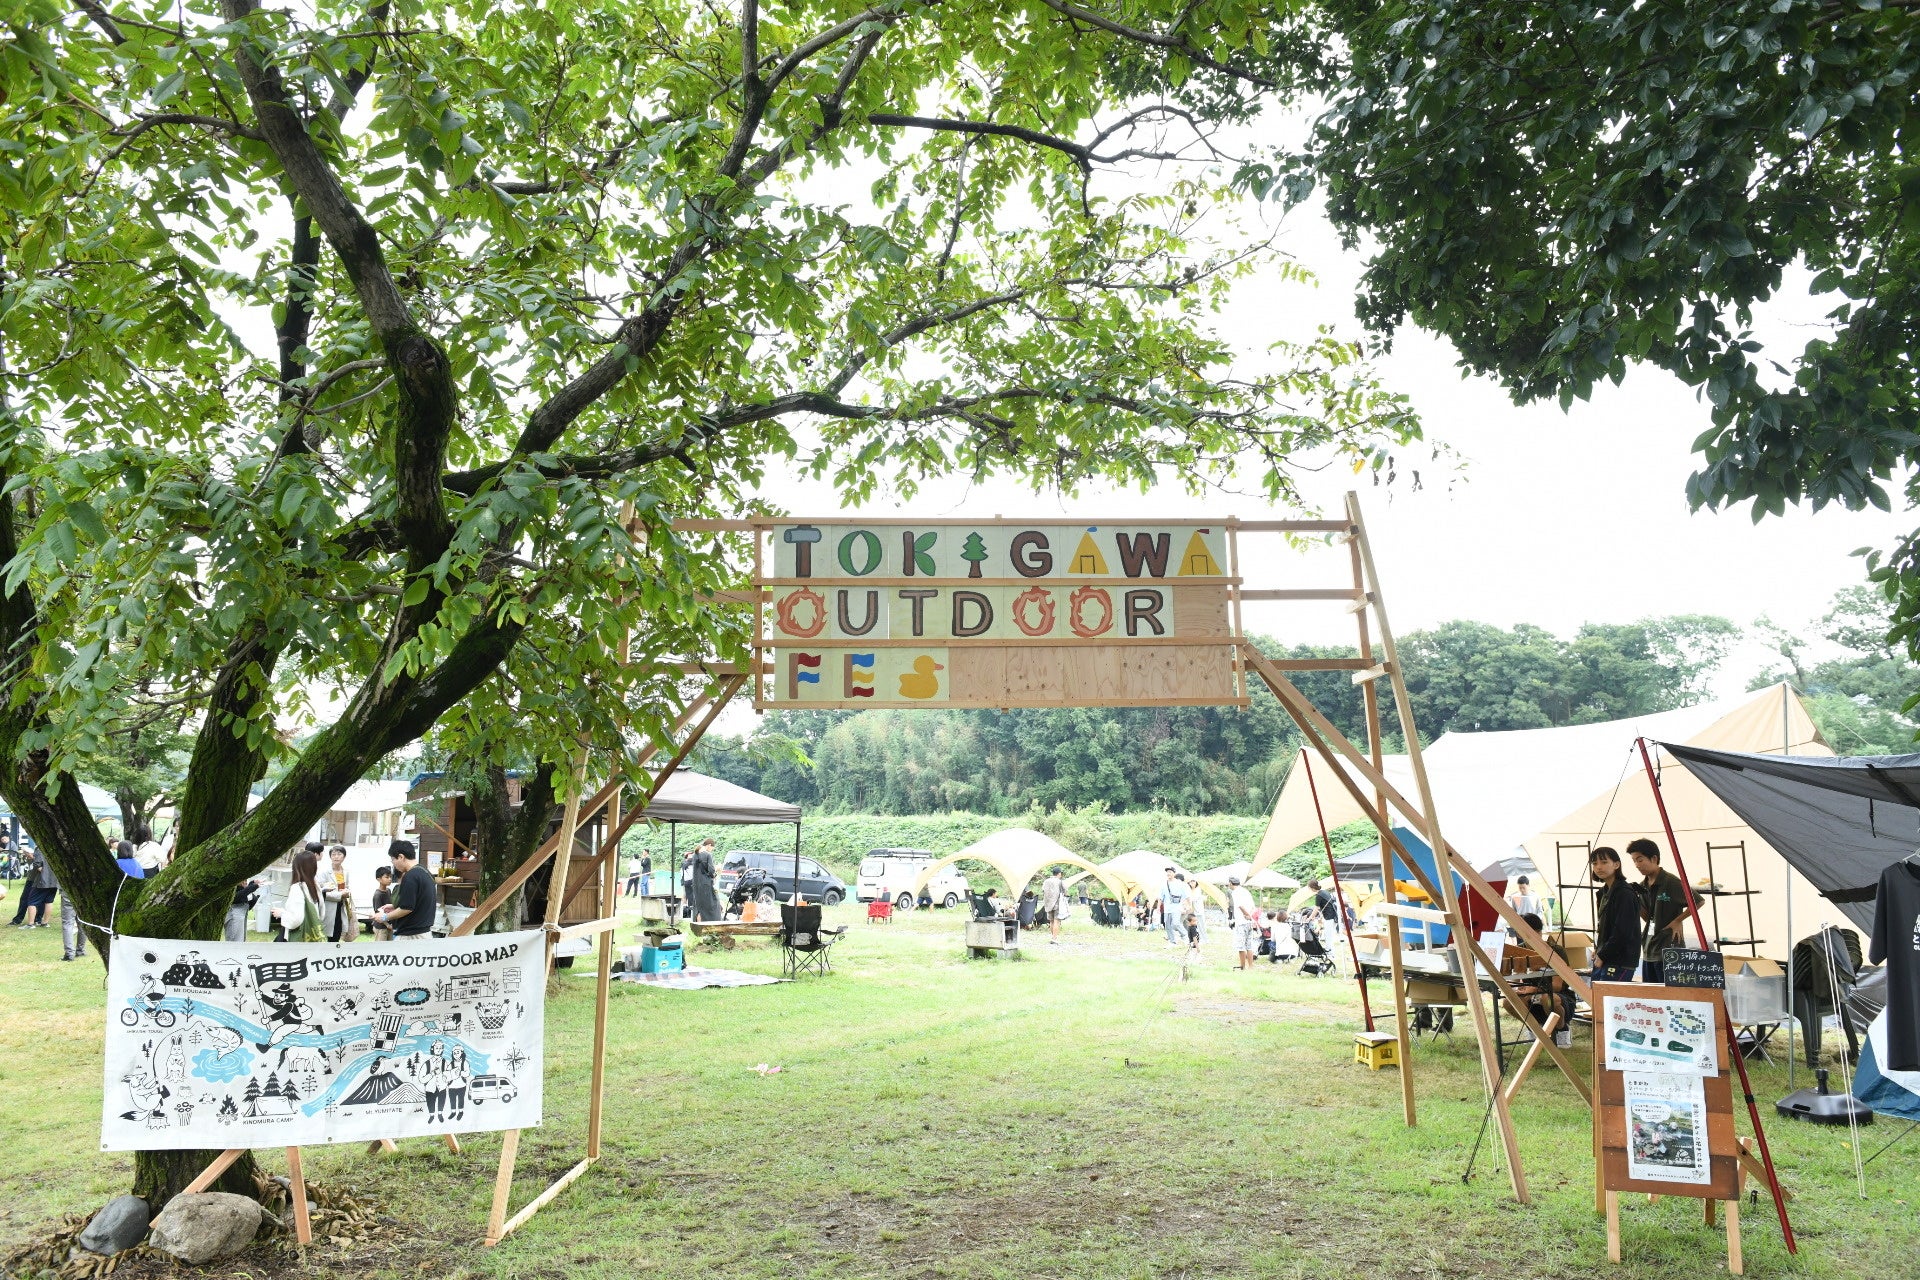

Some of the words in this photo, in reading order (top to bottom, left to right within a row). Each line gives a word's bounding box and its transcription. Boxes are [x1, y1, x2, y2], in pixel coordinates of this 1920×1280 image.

[776, 585, 1165, 638] OUTDOOR
[311, 955, 400, 973] TOKIGAWA
[403, 951, 483, 968] OUTDOOR
[484, 943, 519, 963] MAP
